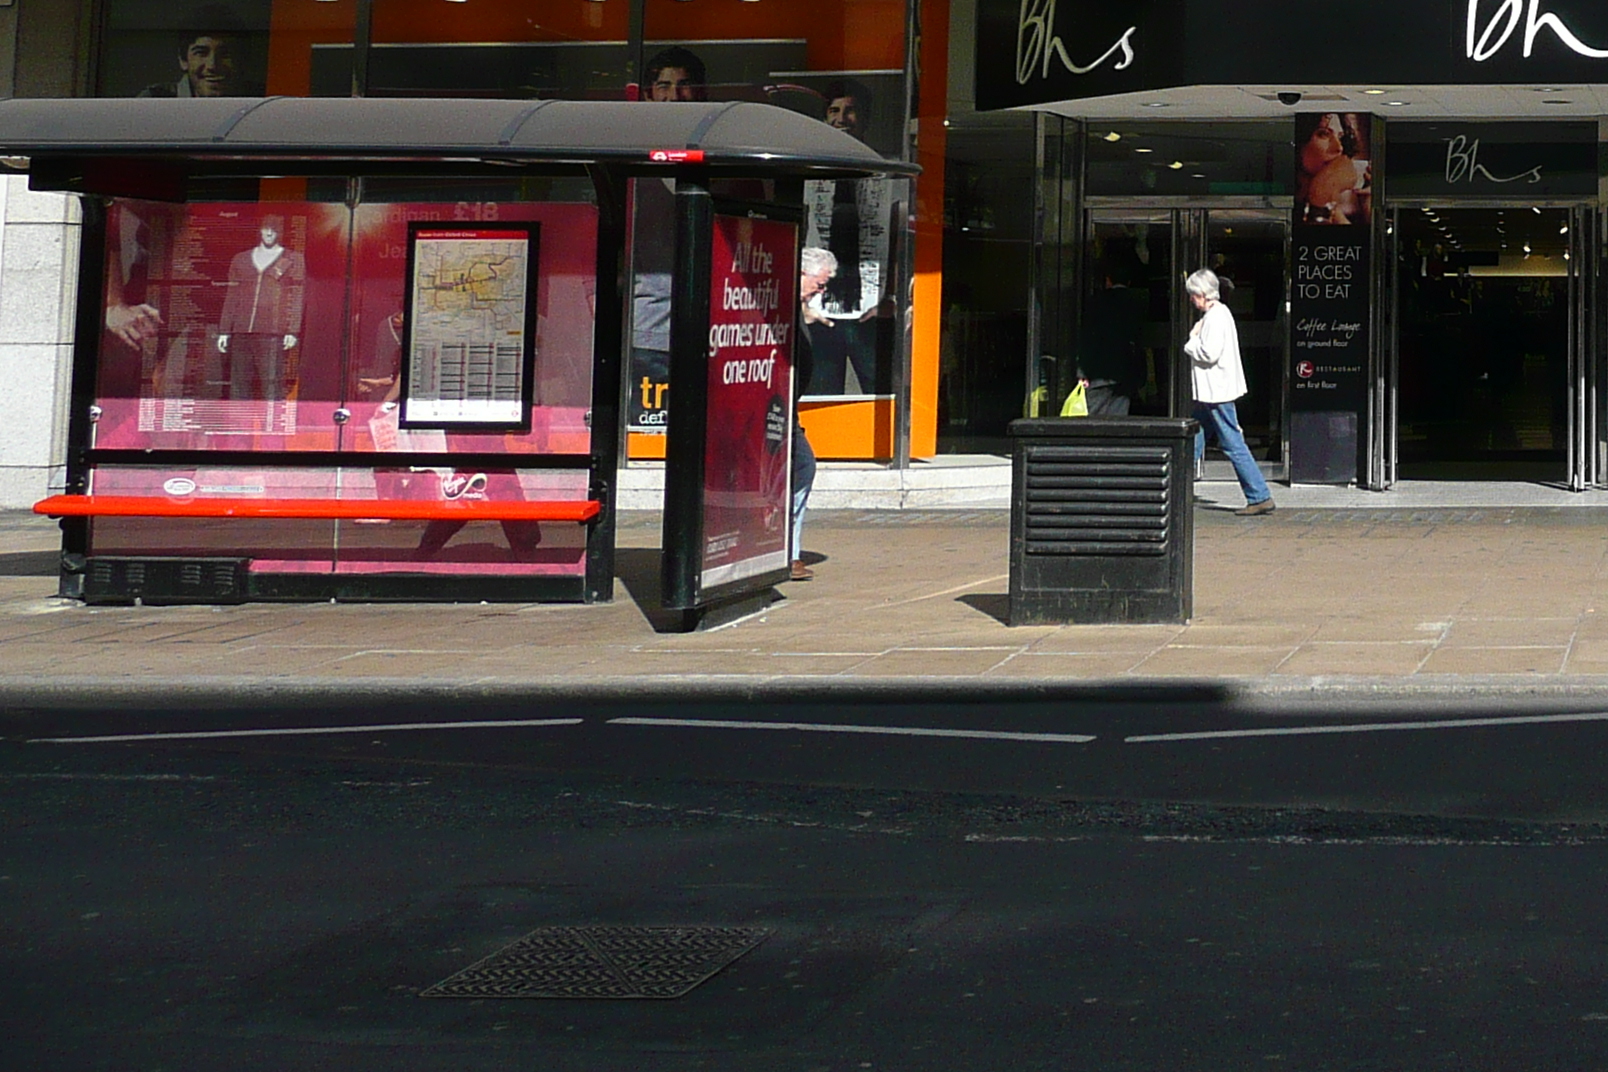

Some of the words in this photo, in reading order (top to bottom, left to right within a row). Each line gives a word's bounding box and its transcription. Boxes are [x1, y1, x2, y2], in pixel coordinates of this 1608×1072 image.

[1445, 134, 1542, 184] Bhs
[454, 201, 499, 221] £18
[731, 242, 750, 273] All
[752, 243, 773, 274] the
[1299, 246, 1309, 261] 2
[1314, 246, 1362, 261] GREAT
[1298, 265, 1352, 280] PLACES
[723, 278, 780, 316] beautiful
[1297, 283, 1320, 299] TO
[1325, 283, 1351, 299] EAT
[709, 323, 753, 357] games
[754, 314, 790, 346] under
[1296, 318, 1327, 337] Coffee
[1331, 319, 1361, 339] Lounge
[1307, 338, 1331, 349] ground
[1332, 338, 1349, 347] floor
[723, 360, 746, 385] one
[747, 349, 777, 389] roof
[1316, 365, 1361, 373] RESTAURANT
[640, 376, 669, 409] tr
[639, 410, 668, 425] def
